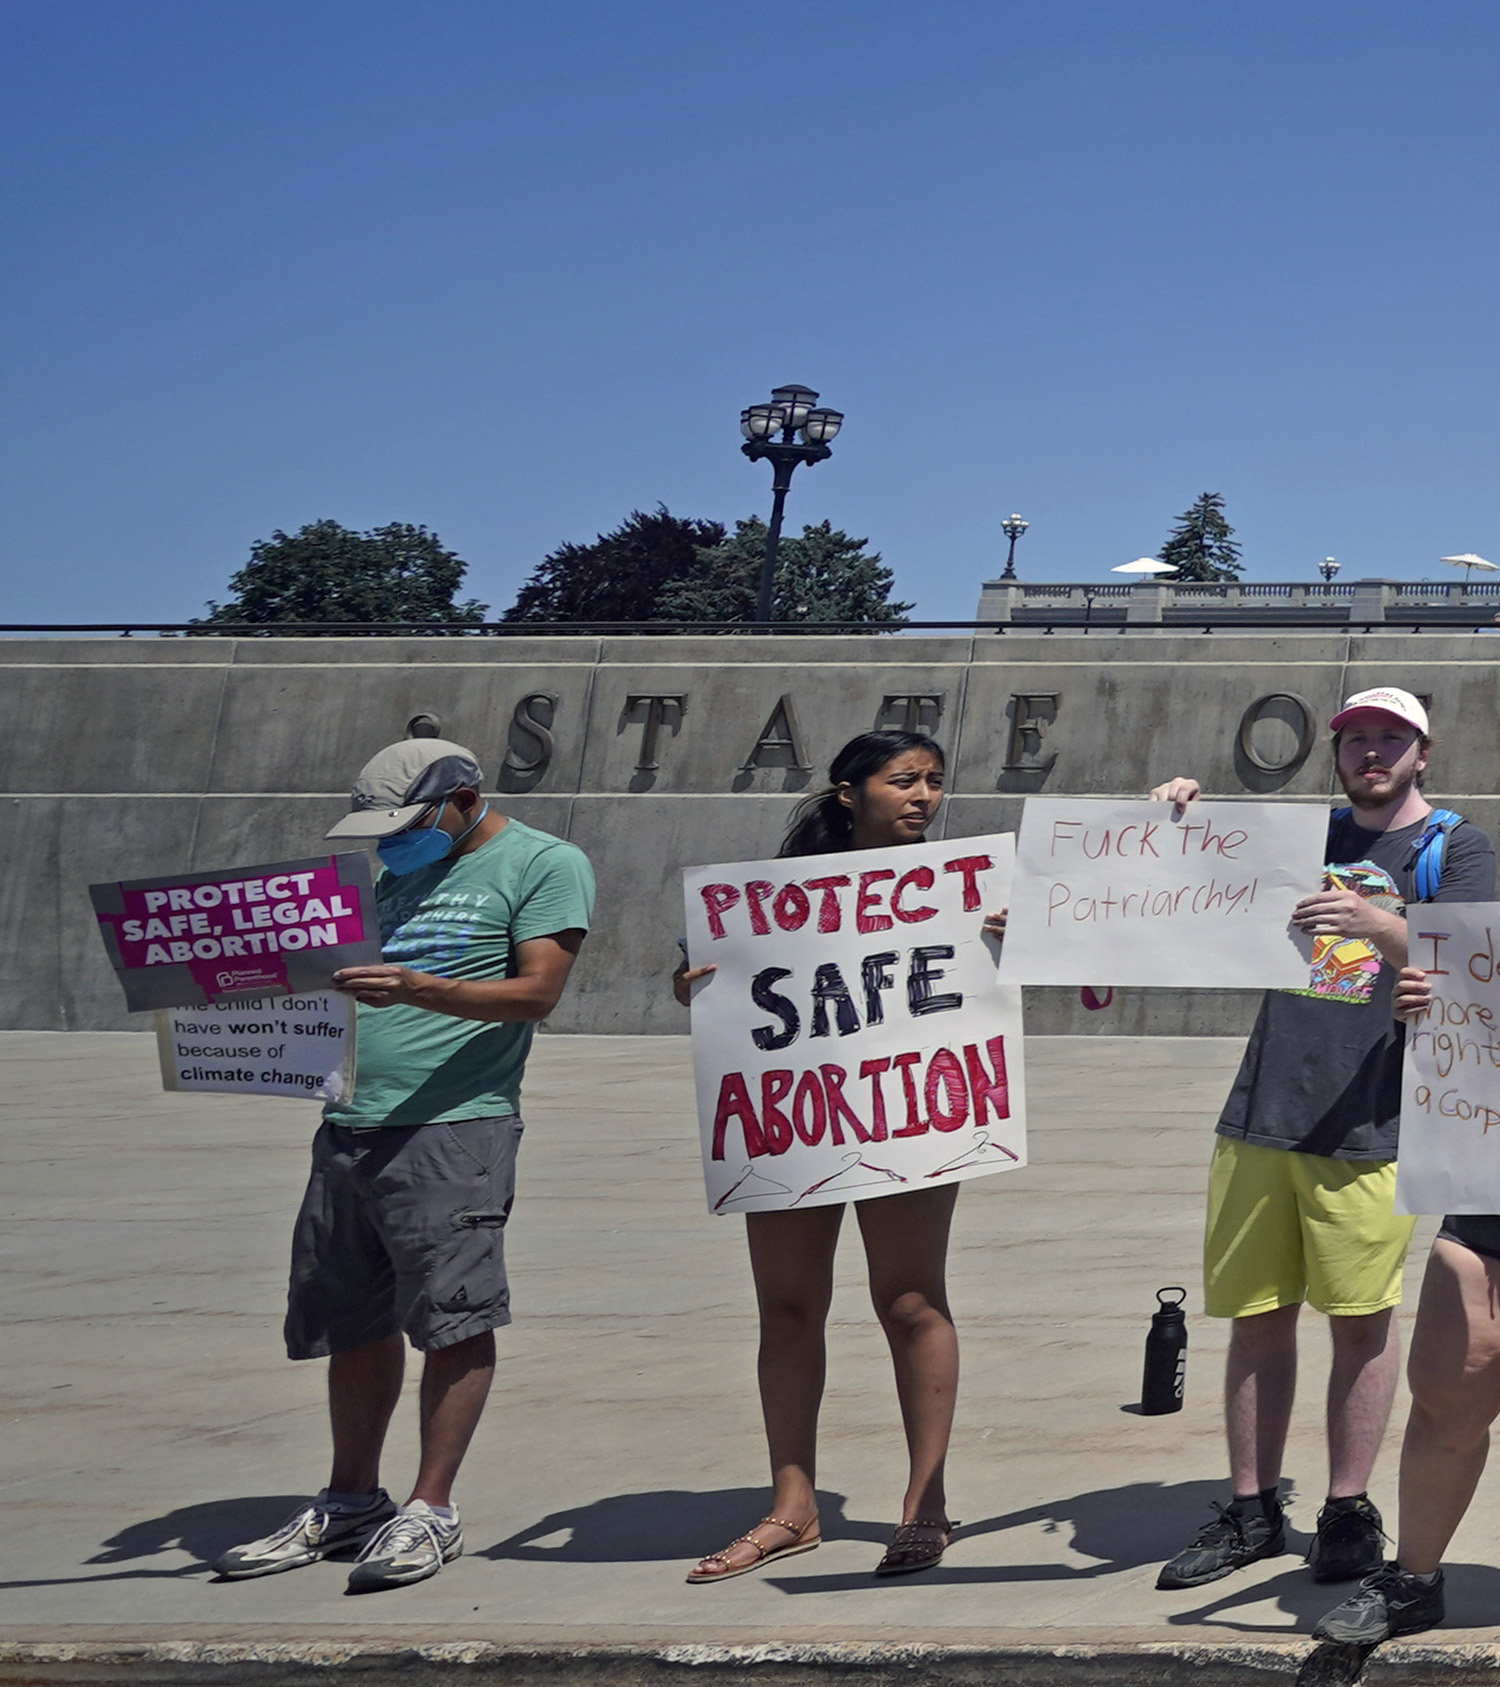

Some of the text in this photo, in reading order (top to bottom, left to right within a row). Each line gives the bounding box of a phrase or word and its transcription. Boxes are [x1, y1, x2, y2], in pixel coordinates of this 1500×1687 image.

[506, 691, 1061, 771] STATE
[144, 872, 316, 914] PROTECT
[379, 893, 490, 914] EALTHY
[1047, 877, 1259, 927] Patriarchy!
[122, 895, 353, 942] SAFE, LEGAL
[145, 922, 339, 966] ABORTION
[1417, 932, 1452, 976] I
[282, 996, 329, 1011] don't
[750, 944, 963, 1052] SAFE
[174, 1019, 345, 1039] have won't suffer
[177, 1043, 287, 1059] because of
[180, 1066, 325, 1090] climate change
[711, 1034, 1011, 1162] ABORTION
[1415, 1085, 1431, 1114] a
